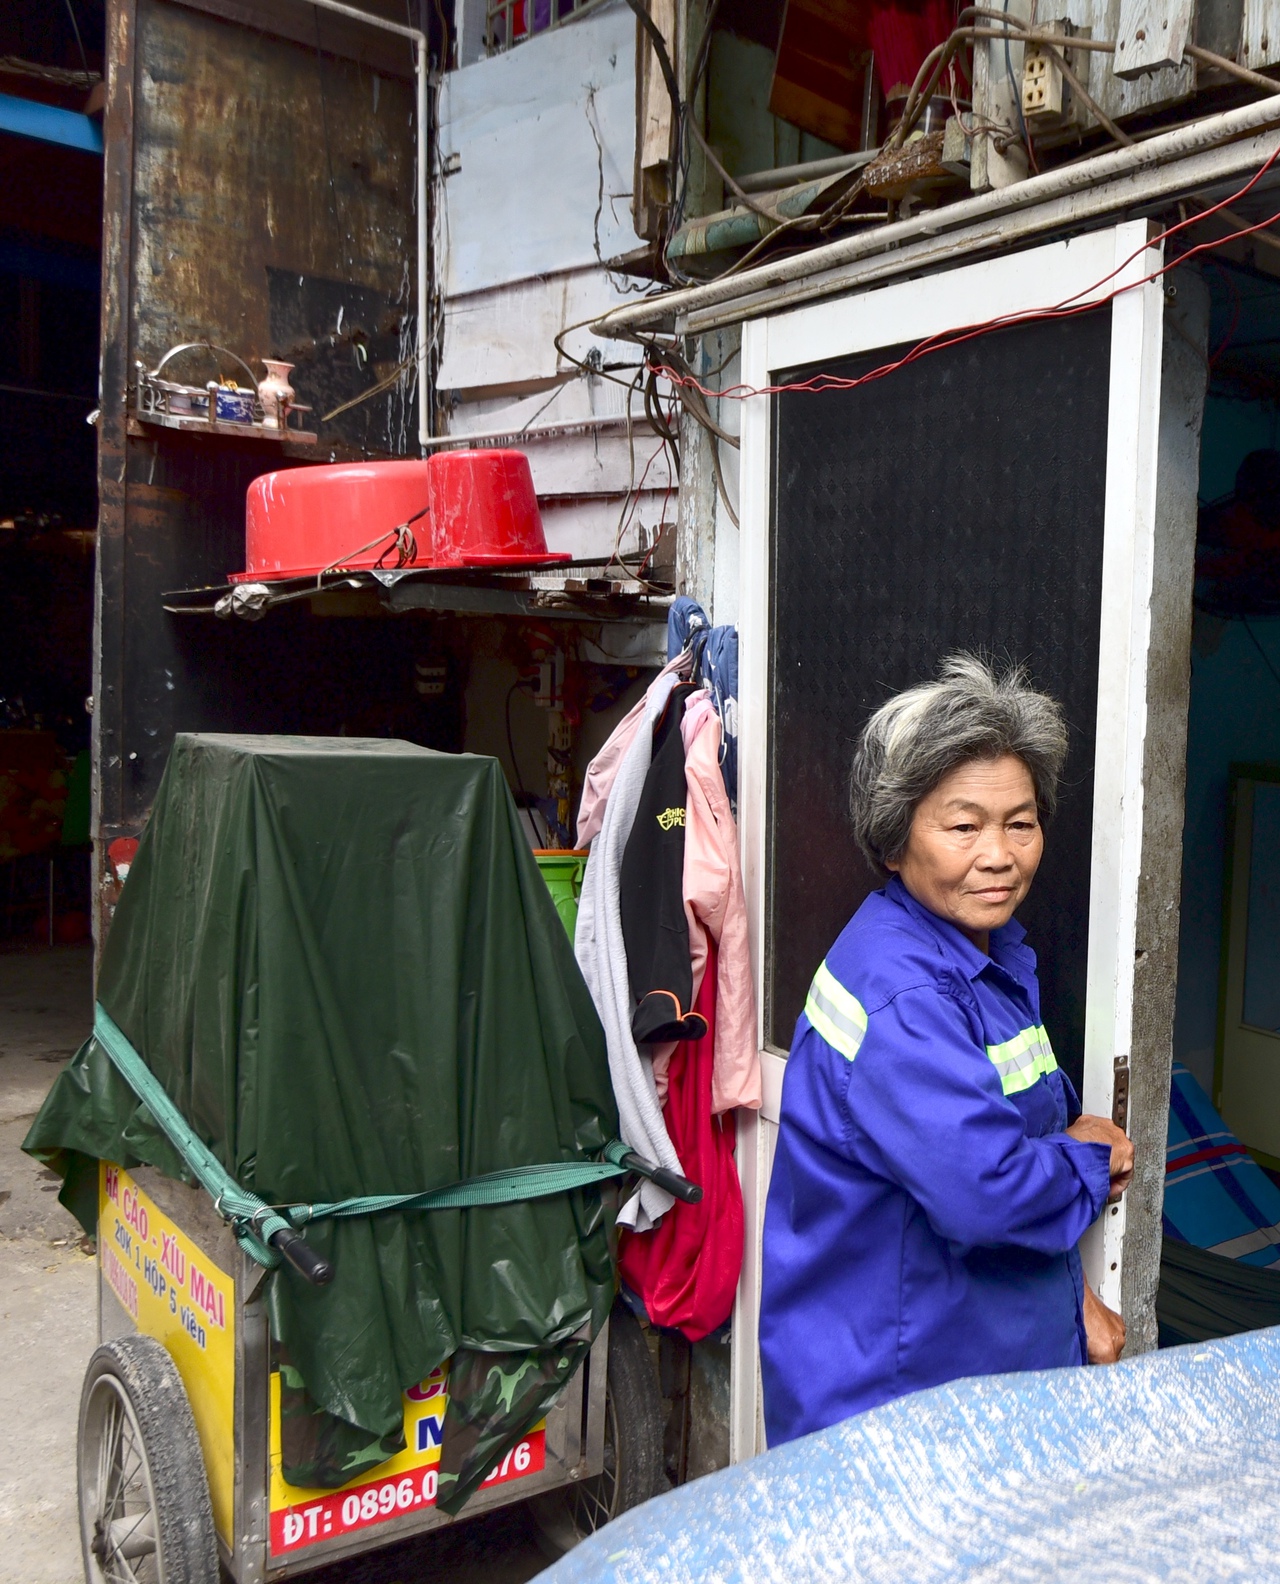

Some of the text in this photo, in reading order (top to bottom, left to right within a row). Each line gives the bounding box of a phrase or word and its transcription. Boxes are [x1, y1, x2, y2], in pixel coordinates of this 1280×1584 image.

[105, 1165, 119, 1208] HÁ
[161, 1232, 185, 1286] XÍU
[190, 1264, 224, 1328] MẠI
[115, 1218, 132, 1259] 20K
[144, 1255, 166, 1297] HỘP
[169, 1286, 177, 1314] 5
[180, 1305, 206, 1349] viên
[283, 1505, 332, 1546] ĐT:
